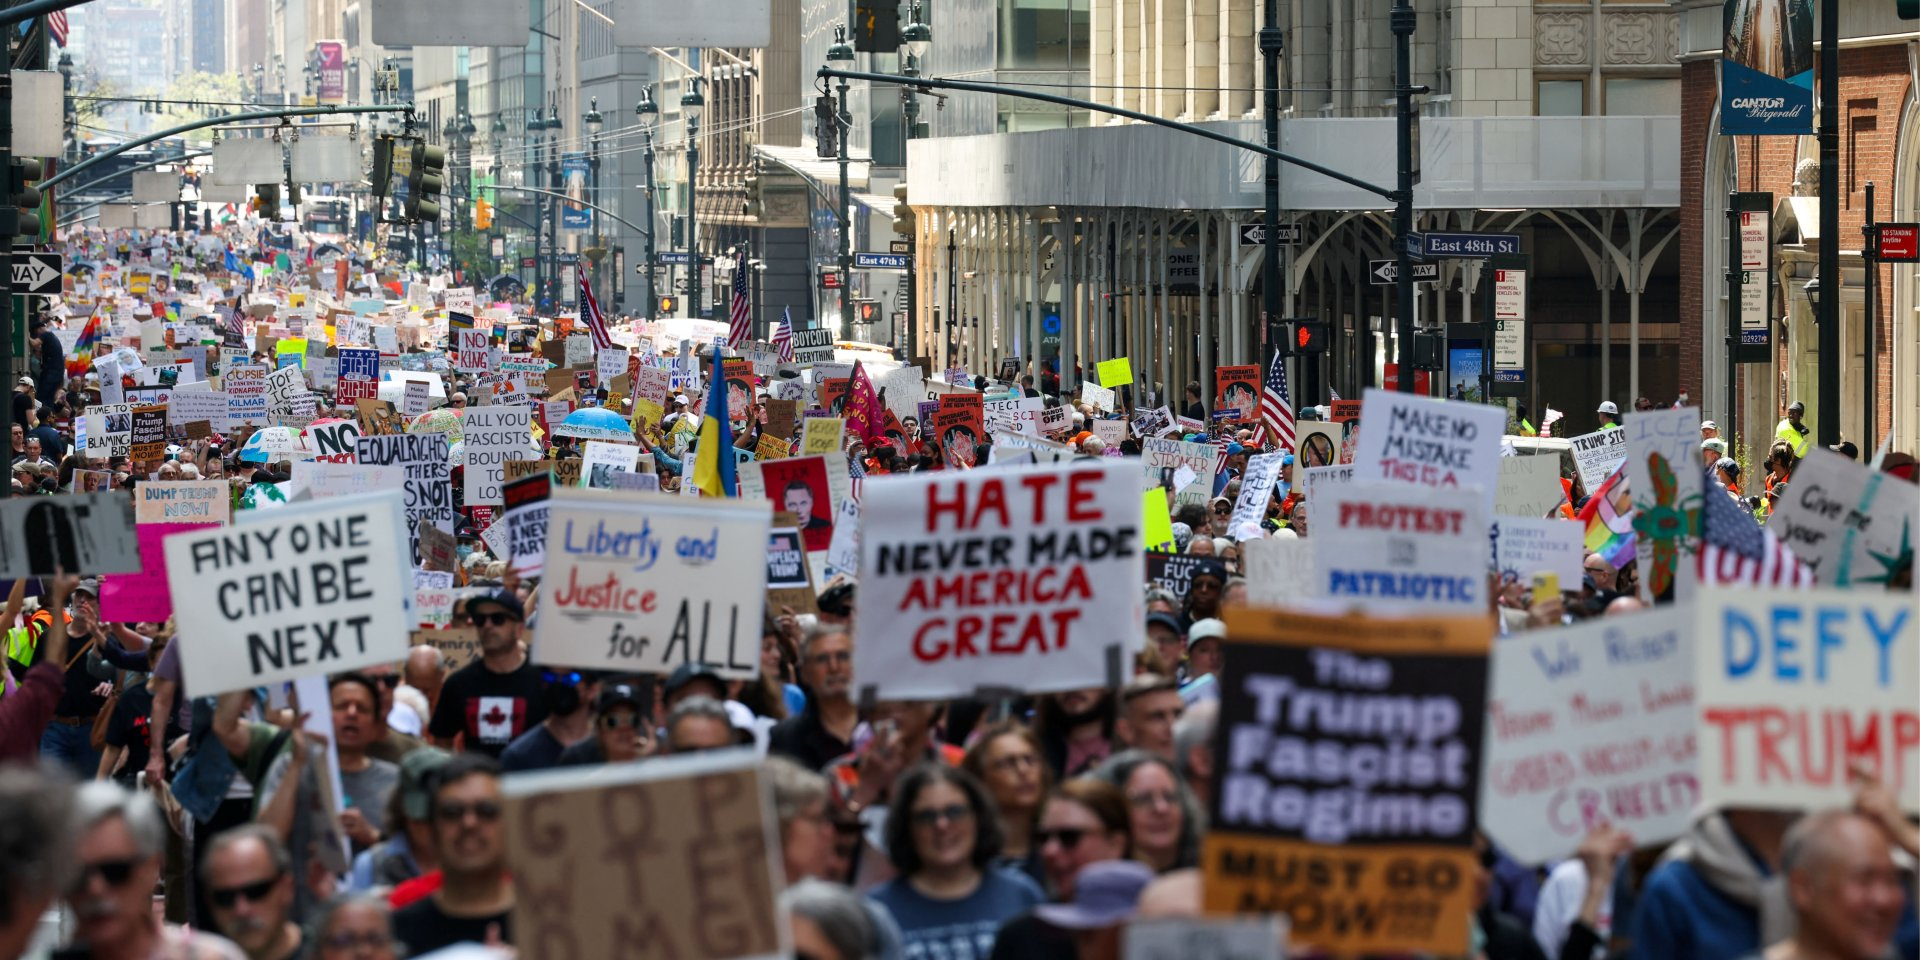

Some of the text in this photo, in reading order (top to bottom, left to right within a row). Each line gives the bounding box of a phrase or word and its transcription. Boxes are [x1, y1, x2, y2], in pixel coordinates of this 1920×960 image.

[1731, 97, 1785, 109] CANTOR
[1746, 104, 1803, 123] Fitzgerald
[1431, 238, 1460, 251] East
[1465, 240, 1494, 253] 48th
[1498, 240, 1513, 253] St
[860, 256, 905, 265] East 47th S
[1743, 272, 1748, 283] 6
[1497, 321, 1502, 330] 6
[465, 332, 486, 348] NO
[793, 329, 832, 347] BOYCOTT
[764, 343, 778, 353] THE
[796, 350, 835, 363] EVERYTHING
[341, 357, 377, 375] FIGHT
[461, 351, 488, 369] KING
[339, 380, 377, 399] RIGHTS
[87, 405, 127, 415] TIME TO
[228, 398, 265, 406] KILMAR
[466, 412, 528, 427] ALL YOU
[1041, 408, 1063, 416] HANDS
[1042, 413, 1064, 424] OFF!
[133, 425, 164, 434] Fascist
[136, 418, 163, 427] Trump
[1389, 405, 1479, 442] MAKE NO
[1634, 415, 1697, 441] ICE
[88, 434, 129, 448] BLAMING
[133, 434, 164, 443] Regime
[314, 423, 359, 455] NO
[464, 431, 531, 446] FASCISTS
[1144, 439, 1181, 454] AMERICA
[1186, 444, 1193, 456] IS
[111, 446, 130, 456] BIDE
[469, 451, 523, 465] BOUND
[1382, 434, 1473, 470] MISTAKE
[406, 463, 448, 479] THERS
[510, 461, 539, 476] HAVE
[1151, 452, 1209, 473] STRONGER
[1380, 459, 1415, 482] THIS
[1441, 470, 1458, 489] A
[145, 487, 218, 500] DUMP TRUMP
[420, 480, 450, 507] NOT
[478, 486, 503, 499] LOS
[164, 501, 209, 516] NOW!
[925, 470, 1106, 534] HATE
[1801, 484, 1872, 533] Give me
[1339, 501, 1466, 535] PROTEST
[1504, 527, 1546, 539] LIBERTY
[1780, 515, 1828, 546] your
[511, 538, 545, 556] PART
[562, 517, 720, 572] Liberty and
[876, 525, 1137, 577] NEVER MADE
[1505, 539, 1570, 552] AND JUSTICE
[1504, 549, 1544, 562] FOR ALL
[769, 562, 800, 578] TRUMP
[217, 566, 301, 621] CAN
[311, 555, 374, 605] BE
[554, 565, 657, 613] Justice
[898, 563, 1094, 612] AMERICA
[1153, 577, 1191, 596] TRU
[1328, 569, 1476, 603] PATRIOTIC
[606, 596, 755, 670] for ALL
[911, 607, 1083, 664] GREAT
[246, 615, 372, 677] NEXT
[1722, 606, 1911, 687] DEFY
[1309, 649, 1392, 690] The
[1243, 674, 1462, 742] Trump
[1704, 705, 1920, 787] TRUMP
[1229, 722, 1469, 790] Fascist
[1220, 773, 1469, 844] Regime
[1218, 851, 1463, 896] MUST GO
